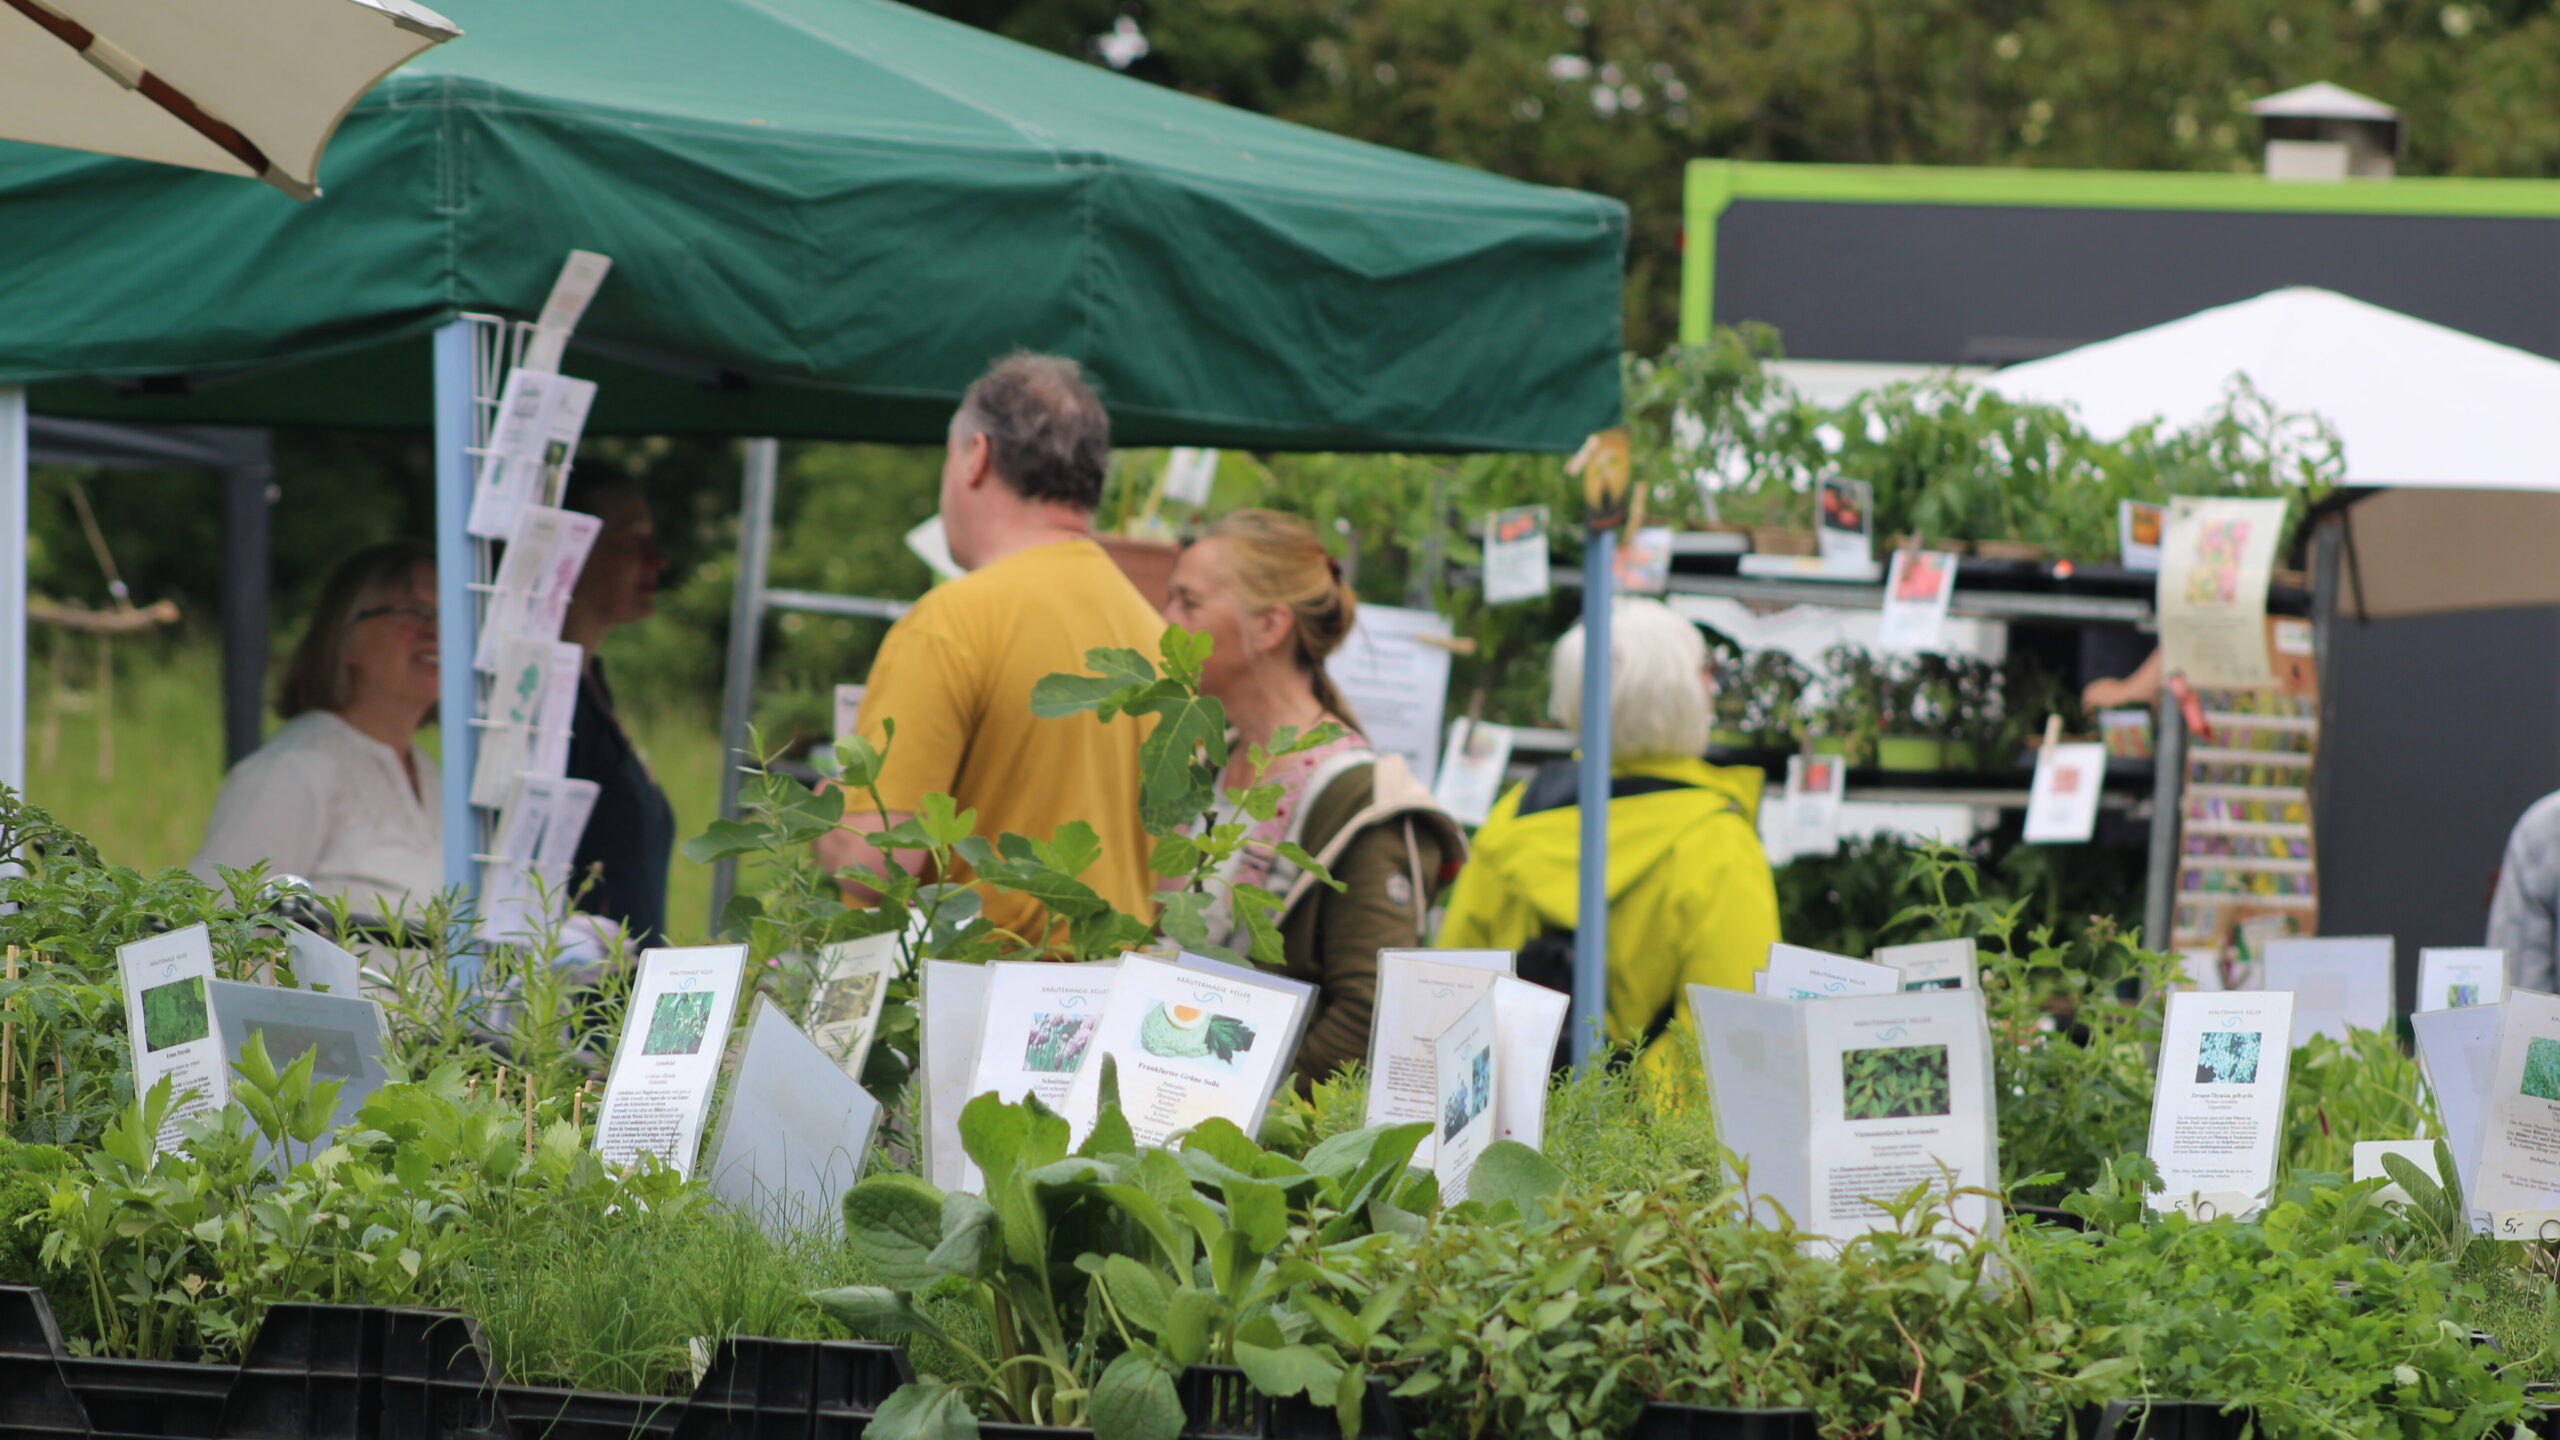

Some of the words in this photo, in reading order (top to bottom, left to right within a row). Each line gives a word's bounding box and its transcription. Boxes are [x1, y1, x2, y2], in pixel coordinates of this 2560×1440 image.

[1177, 976, 1226, 992] KRÄUTERMAGIE
[1229, 989, 1251, 1001] KELLER
[1138, 1061, 1179, 1078] Frankfurter
[1180, 1072, 1202, 1083] Grüne
[1906, 1127, 1940, 1136] Koriander
